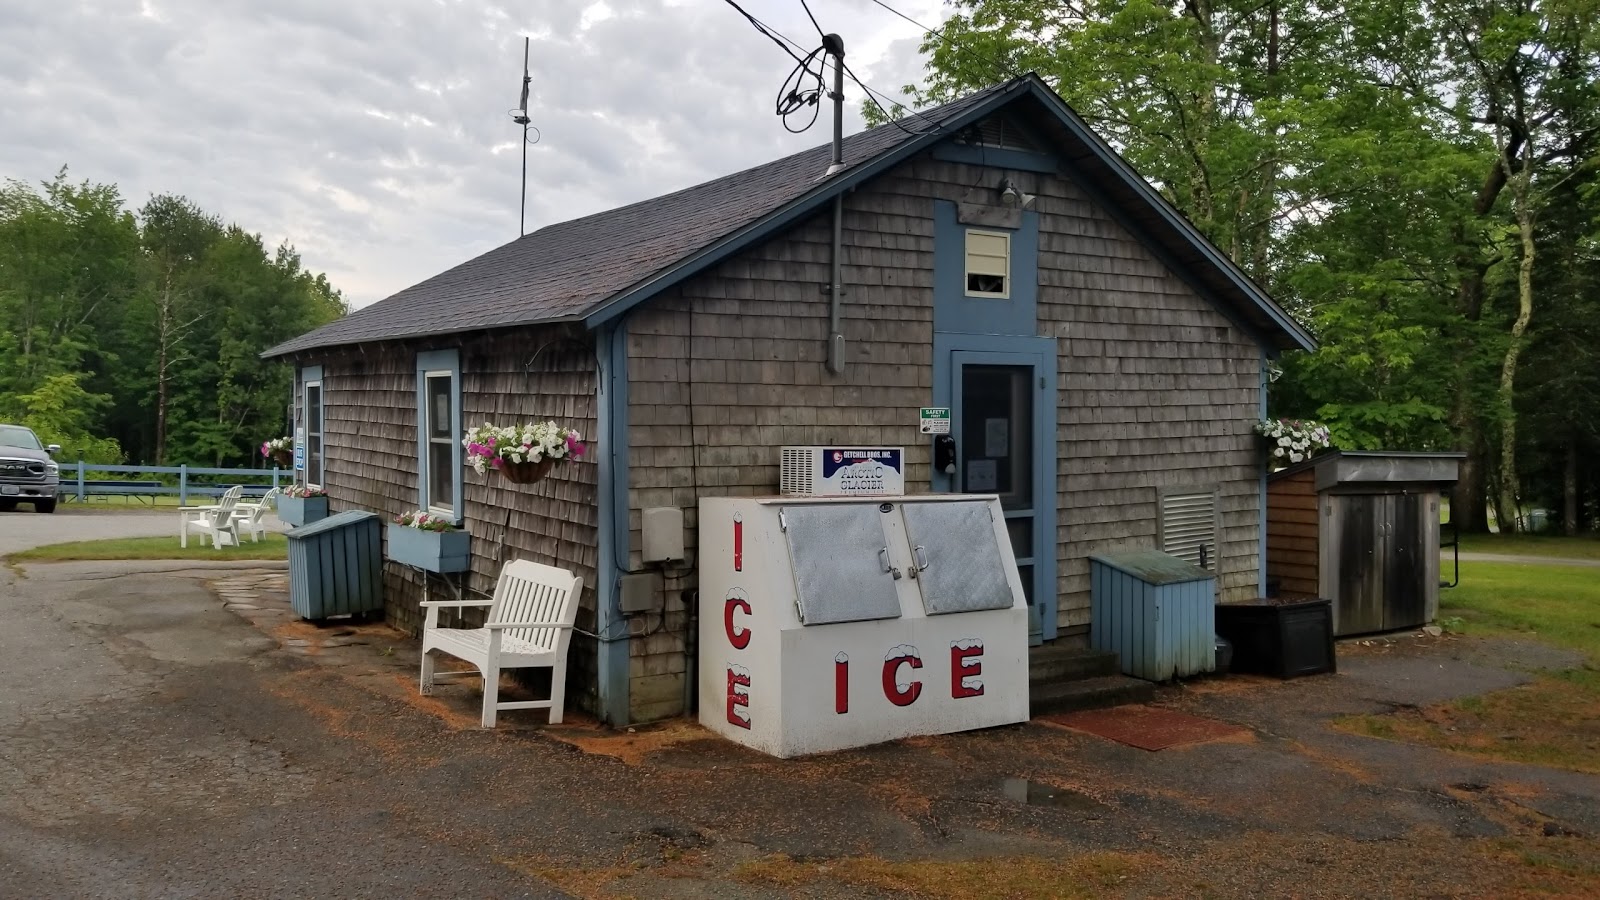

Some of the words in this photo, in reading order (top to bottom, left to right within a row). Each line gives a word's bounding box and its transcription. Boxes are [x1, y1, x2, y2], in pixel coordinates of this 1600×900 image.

[843, 451, 867, 459] GETCHELL
[867, 451, 881, 459] BROS.
[841, 466, 884, 479] ARCTIC
[841, 480, 884, 490] GLACIER
[724, 511, 752, 730] ICE
[834, 637, 985, 715] ICE
